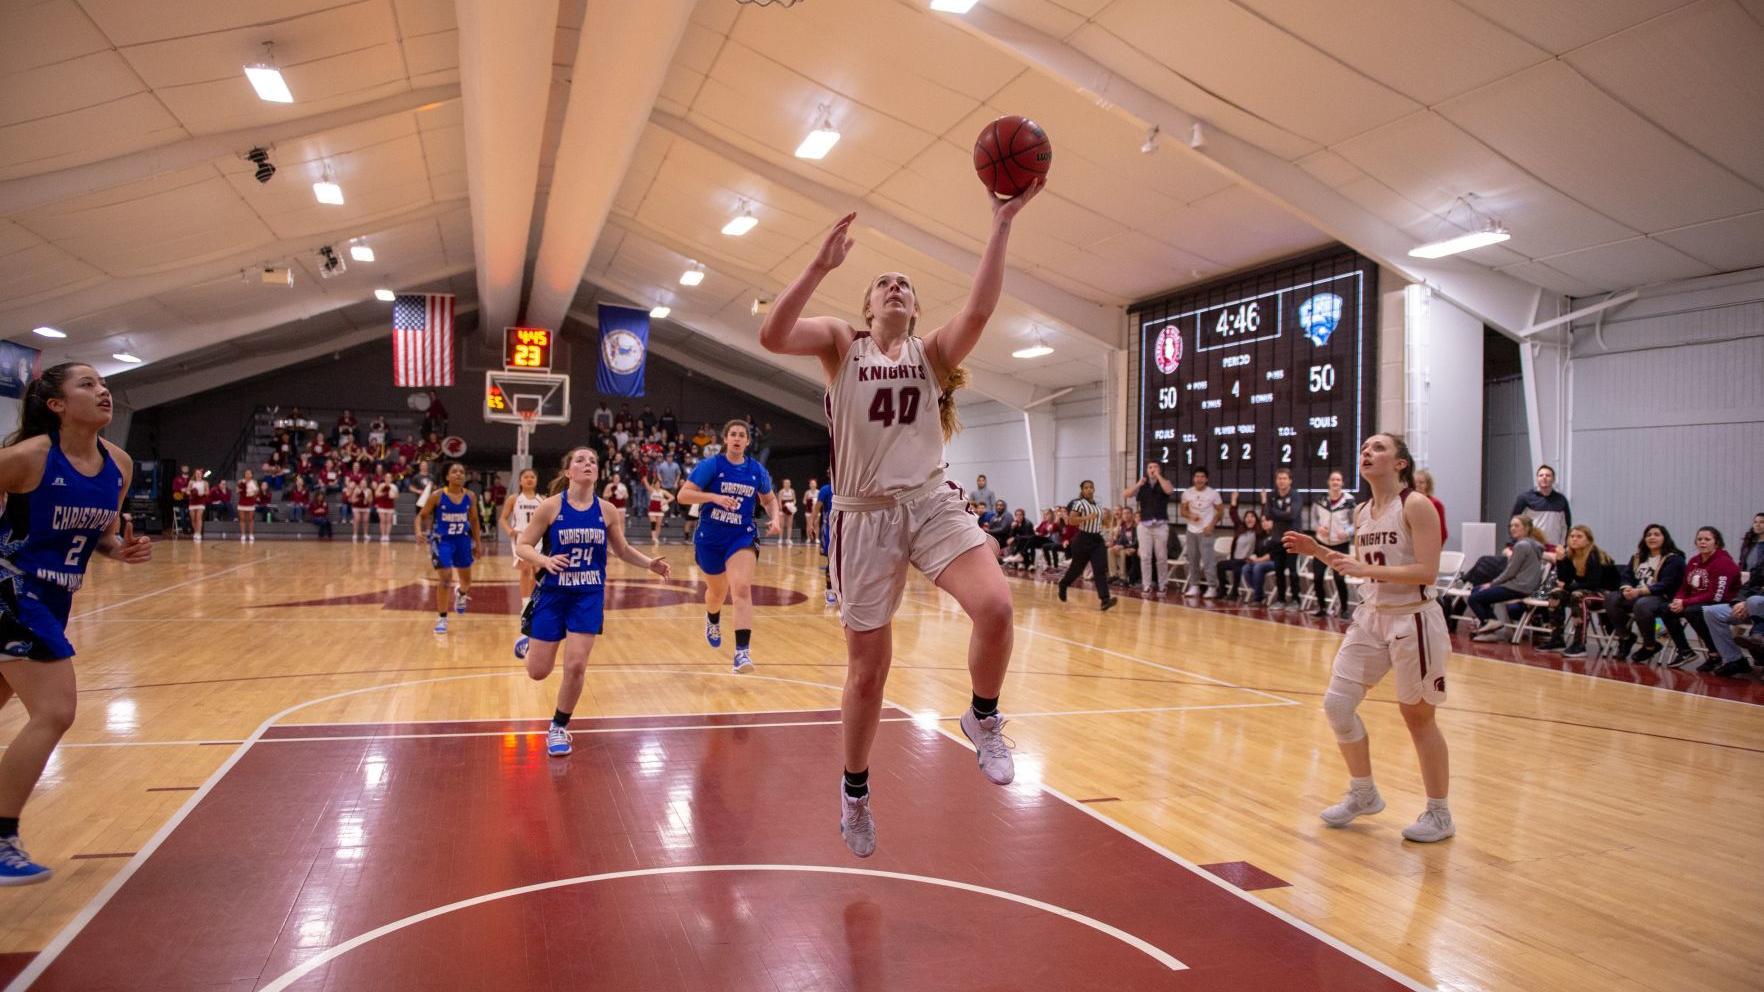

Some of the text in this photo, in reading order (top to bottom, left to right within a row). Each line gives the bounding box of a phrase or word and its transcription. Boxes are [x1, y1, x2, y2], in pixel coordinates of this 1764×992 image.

[1216, 302, 1260, 337] 4:46
[515, 345, 541, 366] 23
[1222, 353, 1250, 368] PERIOD
[858, 364, 926, 382] KNIGHTS
[1309, 363, 1335, 392] 50
[1159, 386, 1178, 410] 50
[1231, 380, 1240, 398] 4
[868, 386, 921, 428] 40
[1161, 446, 1169, 463] 2
[1186, 448, 1193, 465] 1
[1220, 443, 1251, 460] 2 2
[1281, 443, 1292, 463] 2
[1317, 439, 1329, 460] 4
[447, 523, 464, 535] 23
[1357, 531, 1398, 547] NIGHTS
[64, 534, 88, 566] 2
[569, 547, 594, 568] 24
[558, 569, 602, 587] NEWPORT
